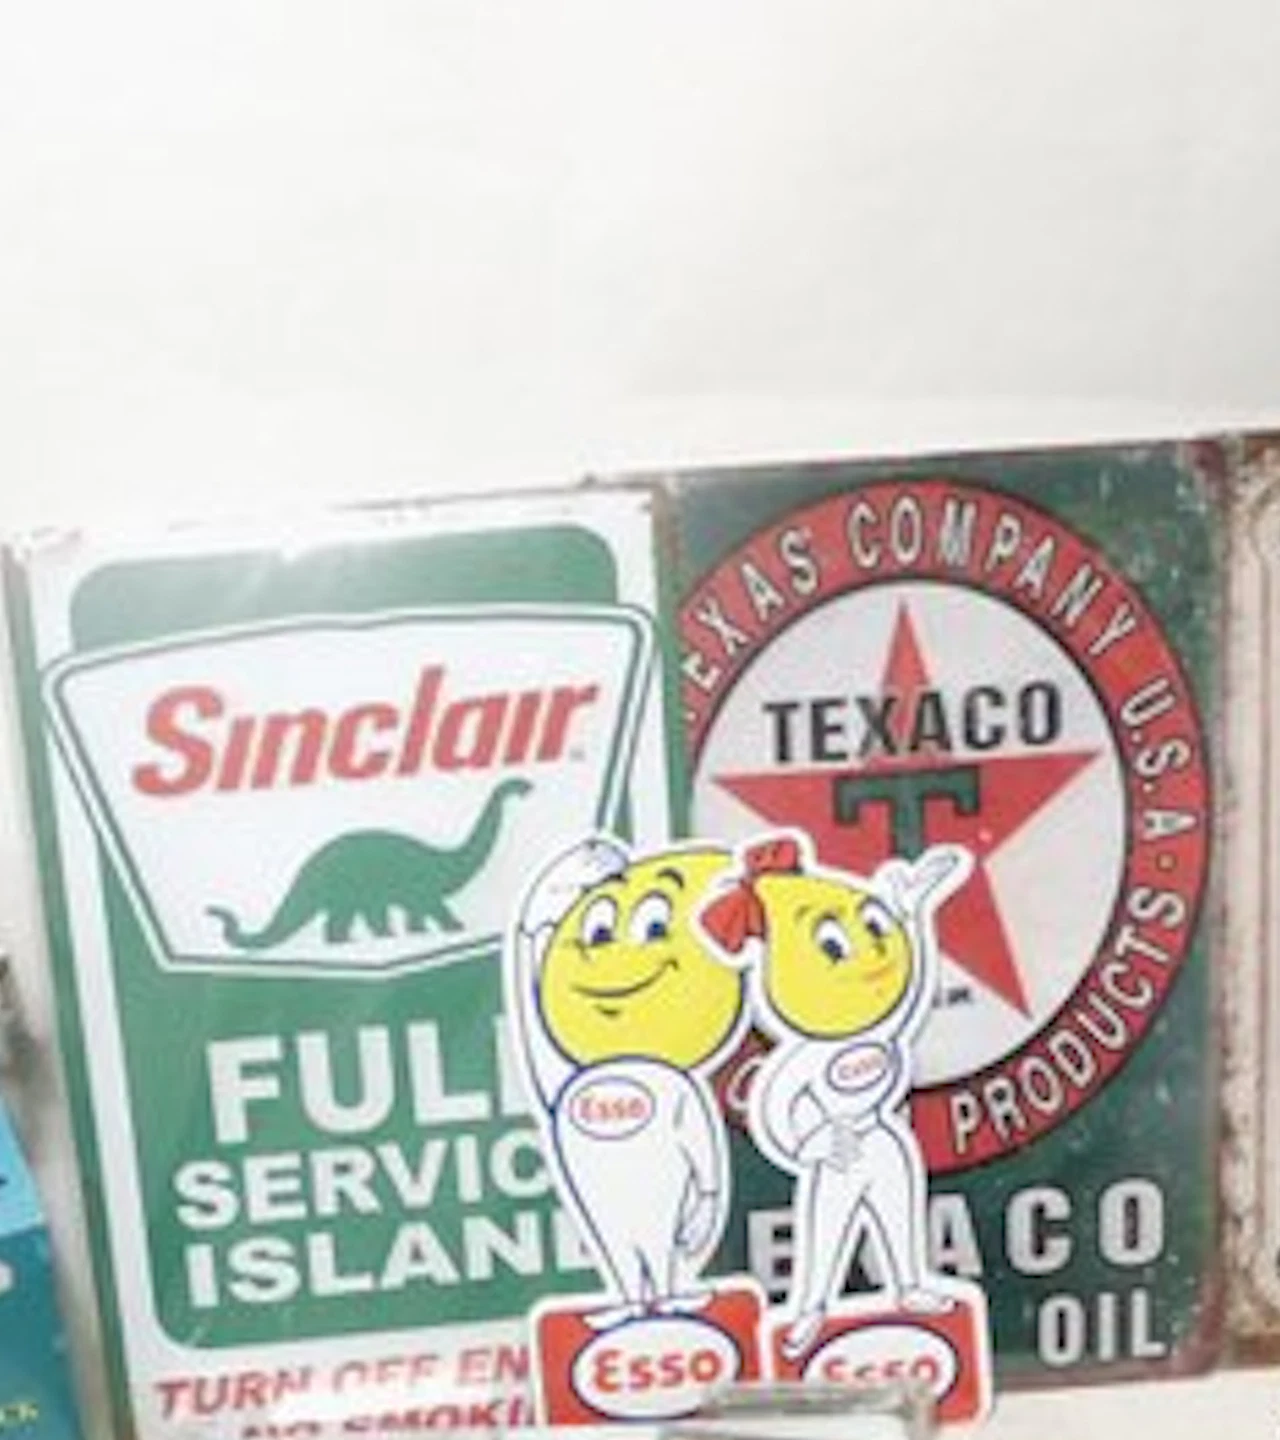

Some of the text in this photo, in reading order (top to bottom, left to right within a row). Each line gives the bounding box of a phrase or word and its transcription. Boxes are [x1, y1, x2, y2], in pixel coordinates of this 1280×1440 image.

[684, 526, 819, 694] EXAS
[847, 496, 1136, 658] COMPANY
[130, 664, 600, 798] Sinclair
[762, 679, 1064, 764] TEXACO
[949, 886, 1186, 1155] PRODUCTS
[174, 1129, 554, 1232] SERVIC
[592, 1347, 724, 1394] Esso
[1038, 1289, 1167, 1367] OIL
[156, 1365, 314, 1420] TURN
